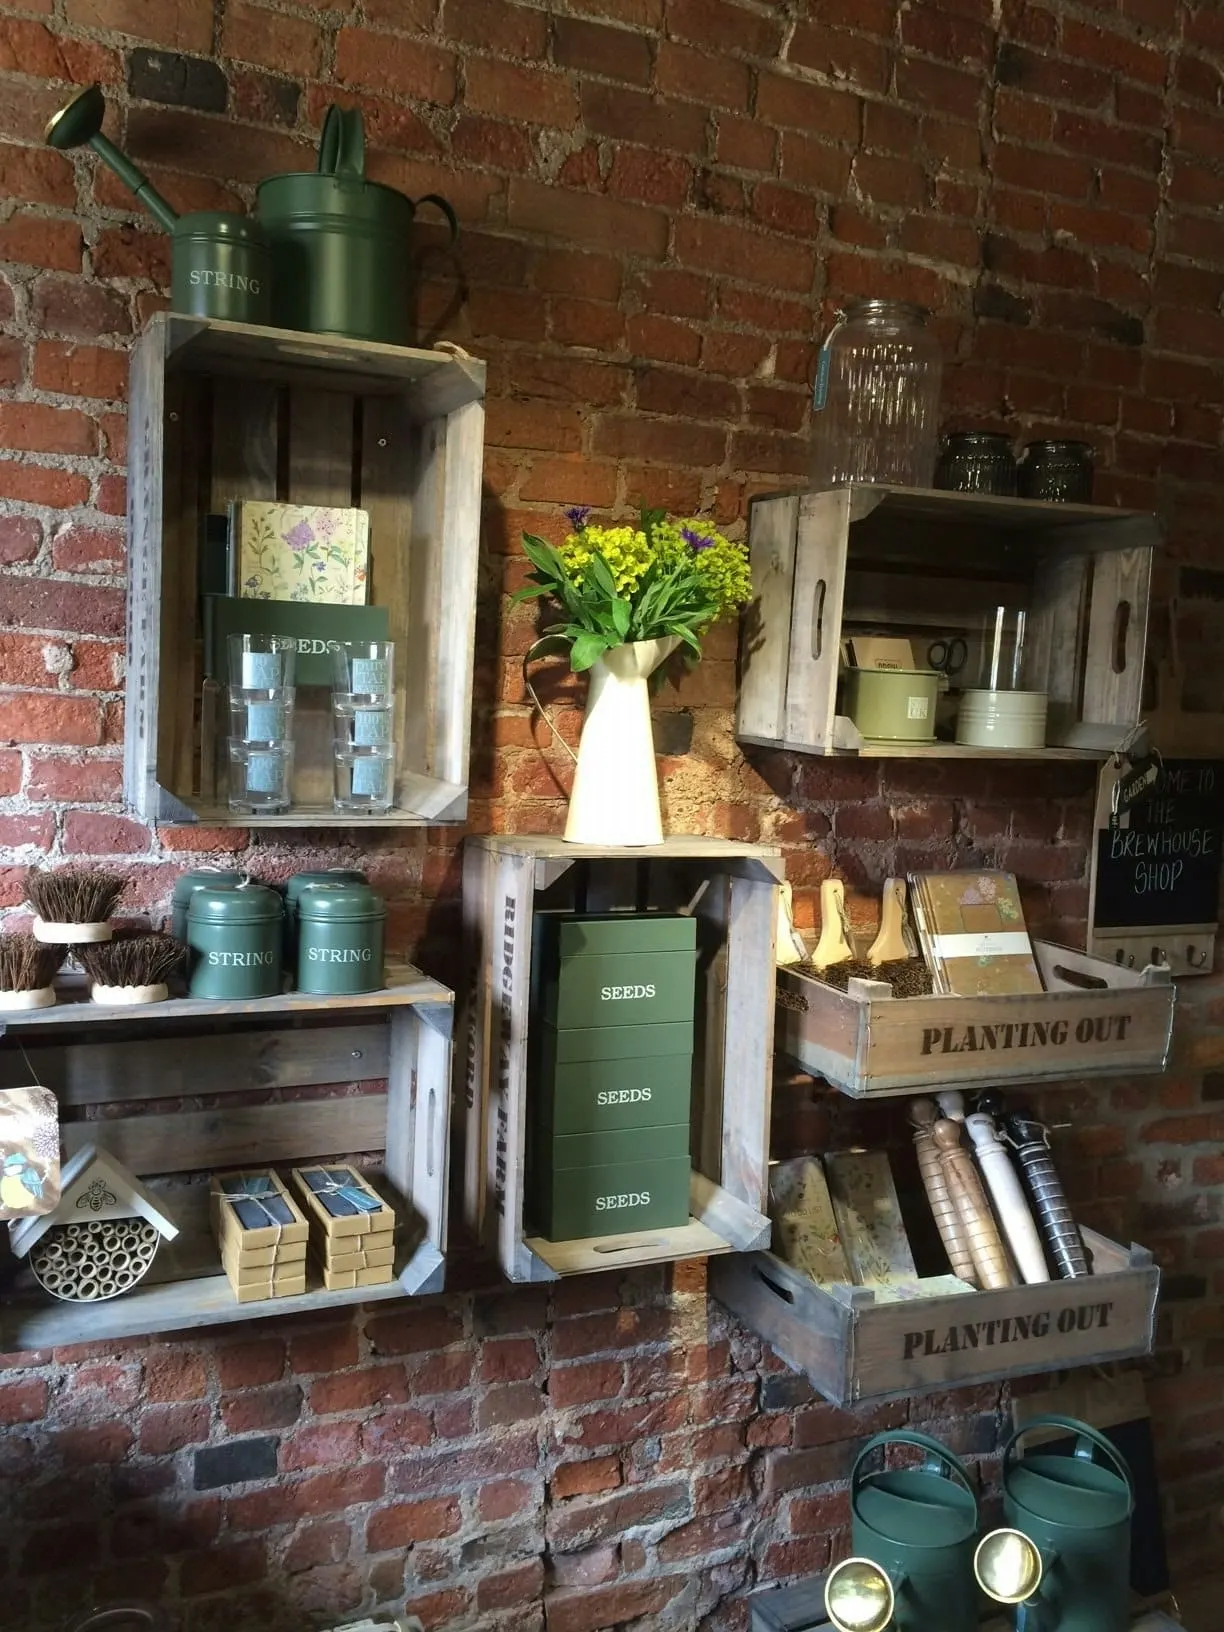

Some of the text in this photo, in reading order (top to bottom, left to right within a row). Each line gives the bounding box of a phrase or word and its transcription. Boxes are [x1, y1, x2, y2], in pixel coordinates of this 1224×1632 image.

[189, 270, 260, 295] STRING
[1111, 828, 1212, 859] BREWHOUSE
[1134, 859, 1183, 895] SHOP
[208, 950, 273, 967] STRING
[308, 947, 372, 963] STRING
[601, 984, 656, 1001] SEEDS
[920, 1015, 1132, 1056] PLANTING OUT
[494, 895, 516, 1217] RIDGEWAY FARM
[597, 1087, 652, 1106] SEEDS
[595, 1191, 650, 1211] SEEDS
[902, 1302, 1114, 1361] PLANTING OUT
